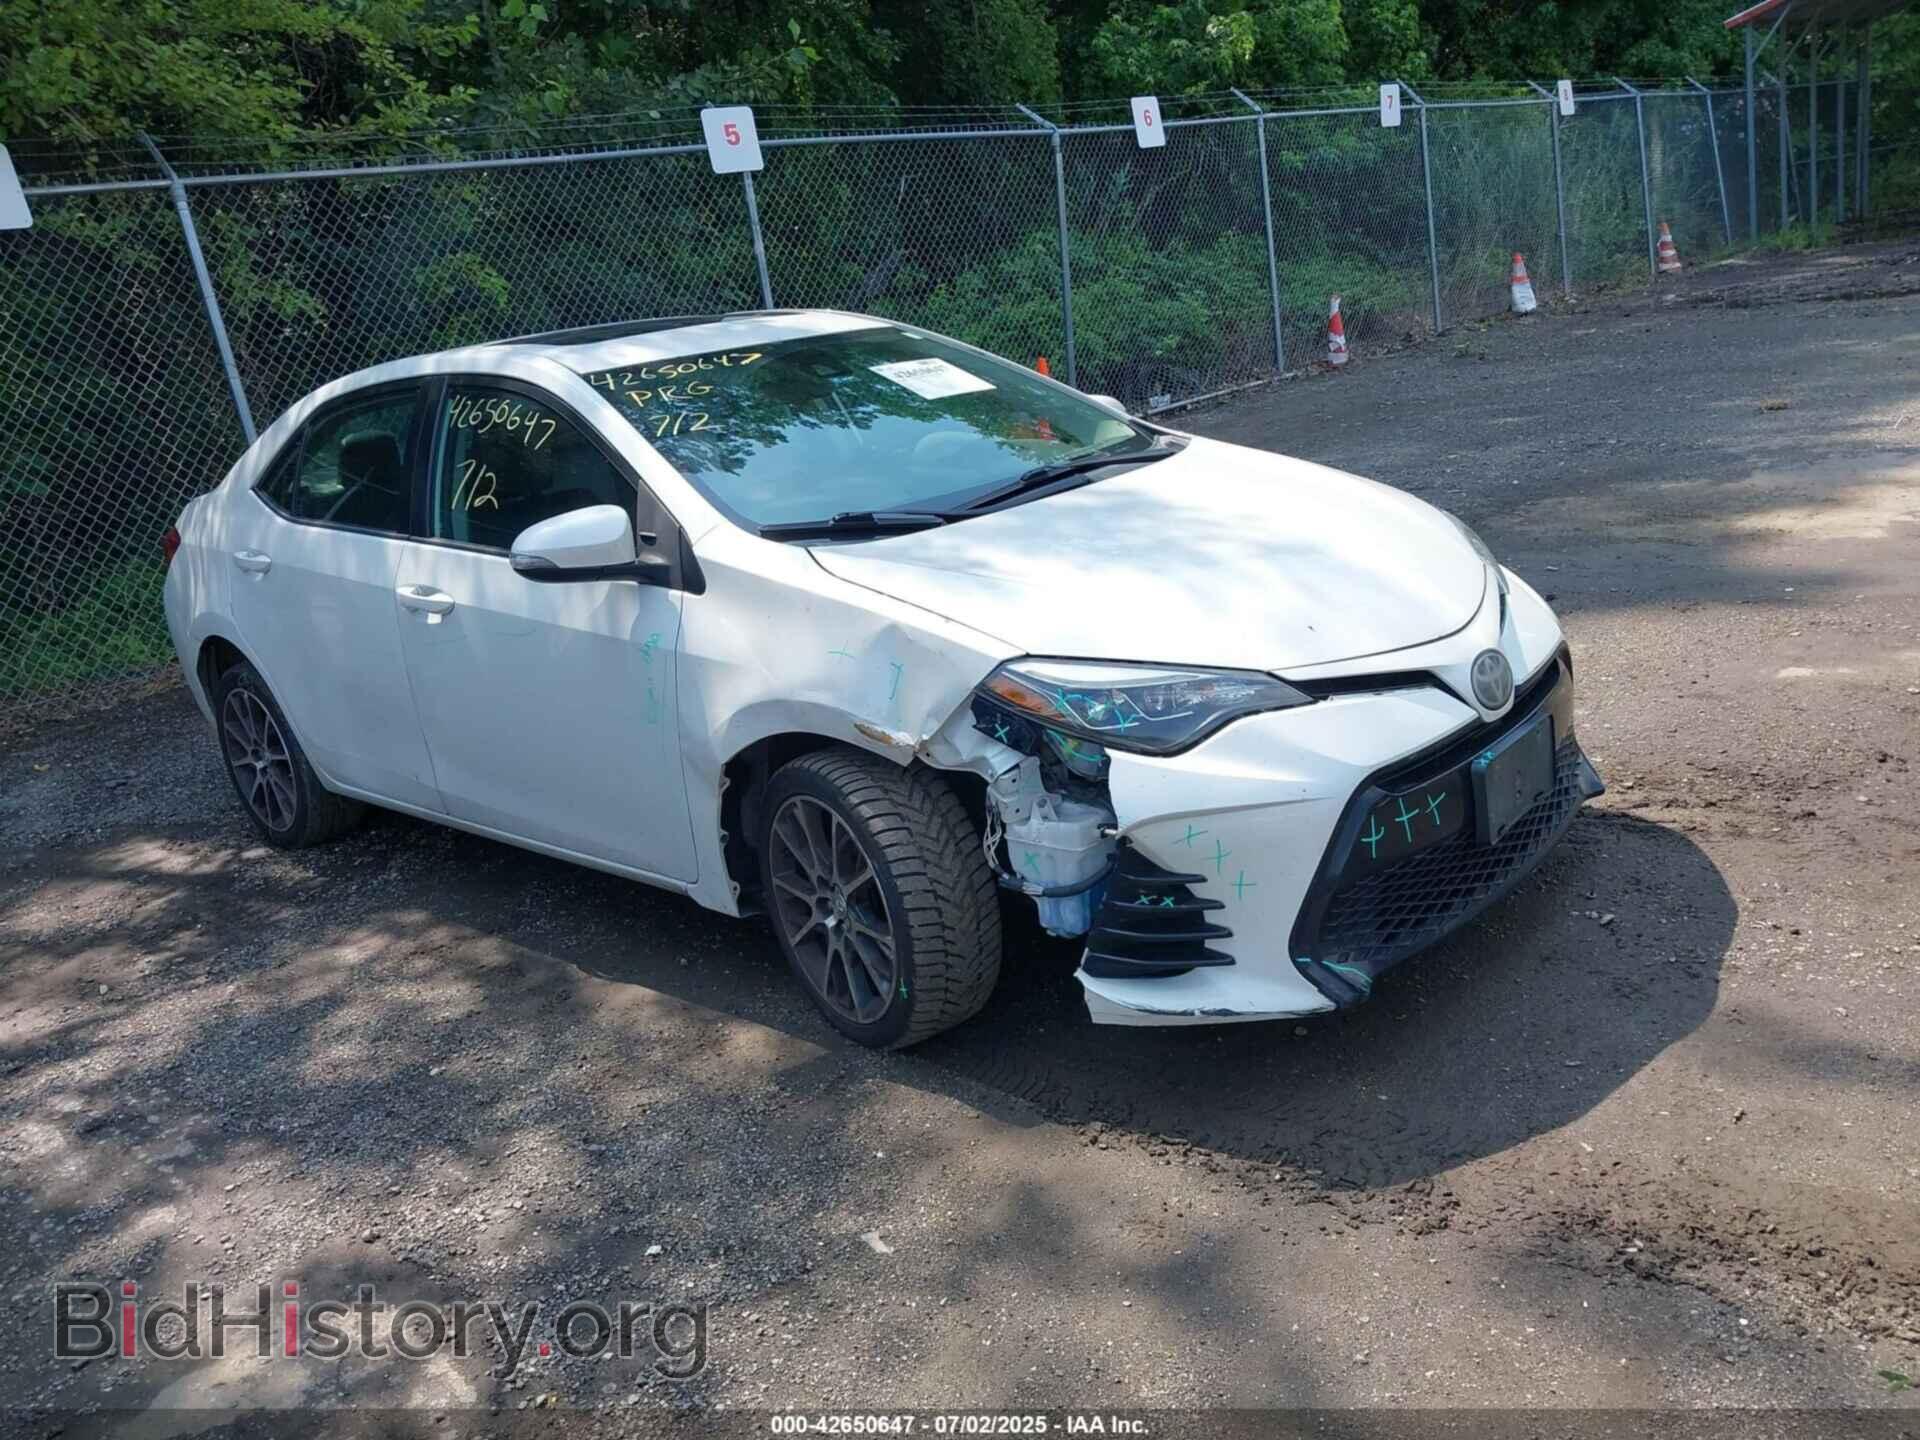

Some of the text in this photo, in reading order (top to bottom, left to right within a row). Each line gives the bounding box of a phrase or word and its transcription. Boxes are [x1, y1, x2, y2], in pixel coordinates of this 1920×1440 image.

[1385, 95, 1393, 110] 7
[1143, 109, 1153, 127] 6
[723, 123, 741, 146] 5
[590, 352, 763, 391] 42650647
[625, 381, 714, 408] PRG
[449, 394, 556, 450] 42650647
